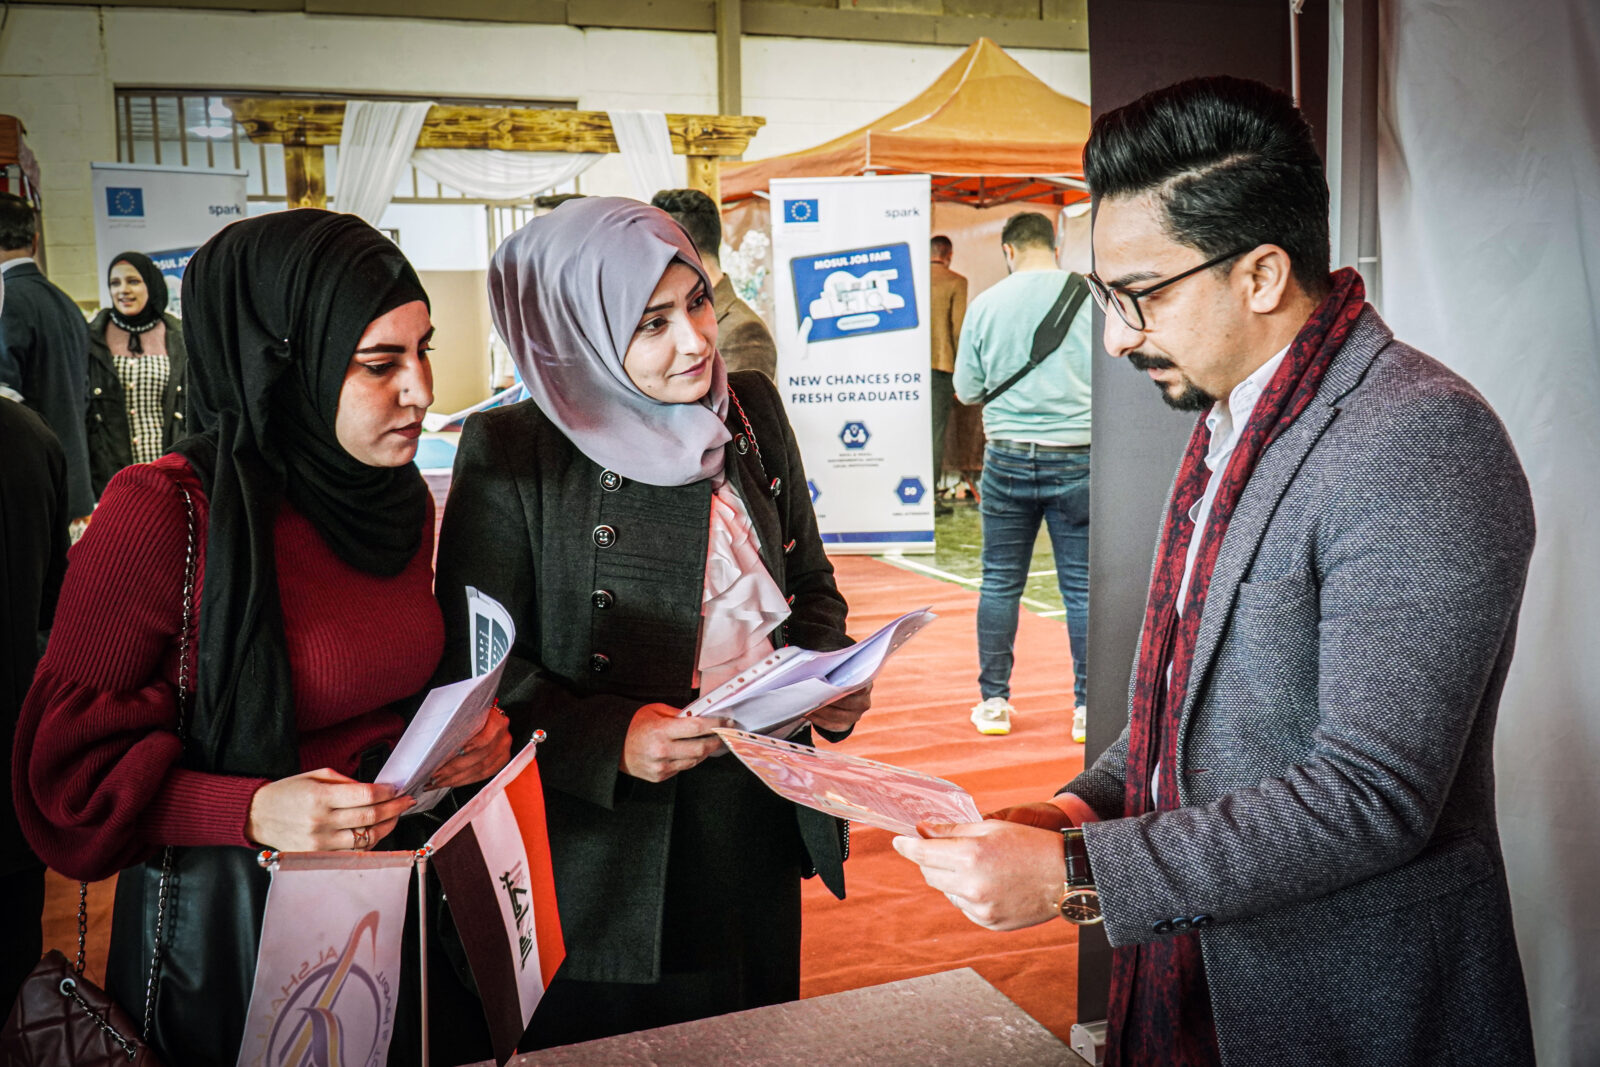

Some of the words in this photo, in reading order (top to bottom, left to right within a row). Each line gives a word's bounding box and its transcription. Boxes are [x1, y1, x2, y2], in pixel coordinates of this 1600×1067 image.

[208, 204, 241, 217] spark
[885, 207, 920, 218] spark
[814, 257, 848, 270] MOSUL
[850, 254, 869, 265] JOB
[869, 250, 892, 262] FAIR
[789, 376, 821, 386] NEW
[826, 374, 890, 385] CHANCES
[895, 373, 921, 383] FOR
[792, 392, 832, 404] FRESH
[837, 390, 920, 402] GRADUATES
